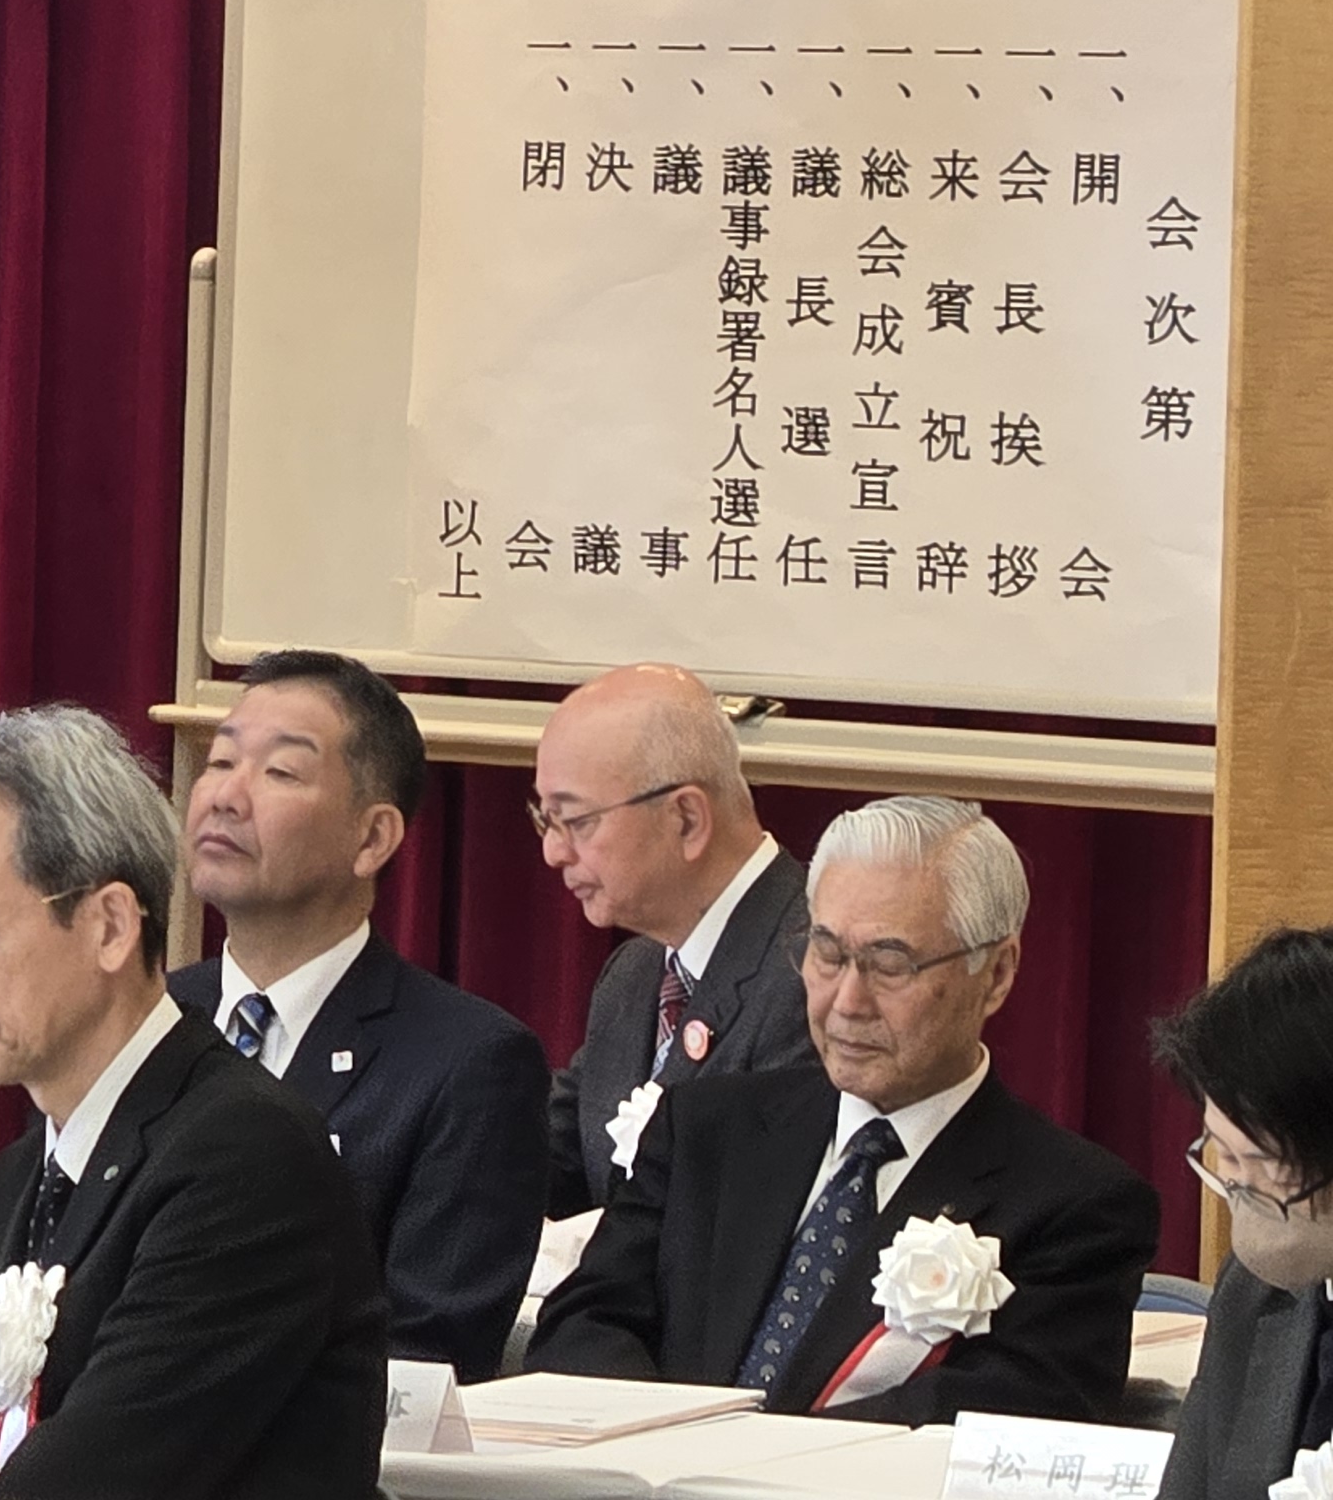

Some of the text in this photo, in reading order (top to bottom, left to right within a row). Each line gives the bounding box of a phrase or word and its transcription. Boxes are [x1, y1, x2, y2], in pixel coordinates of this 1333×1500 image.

[1141, 196, 1201, 442] 会次第
[438, 499, 483, 602] 以上
